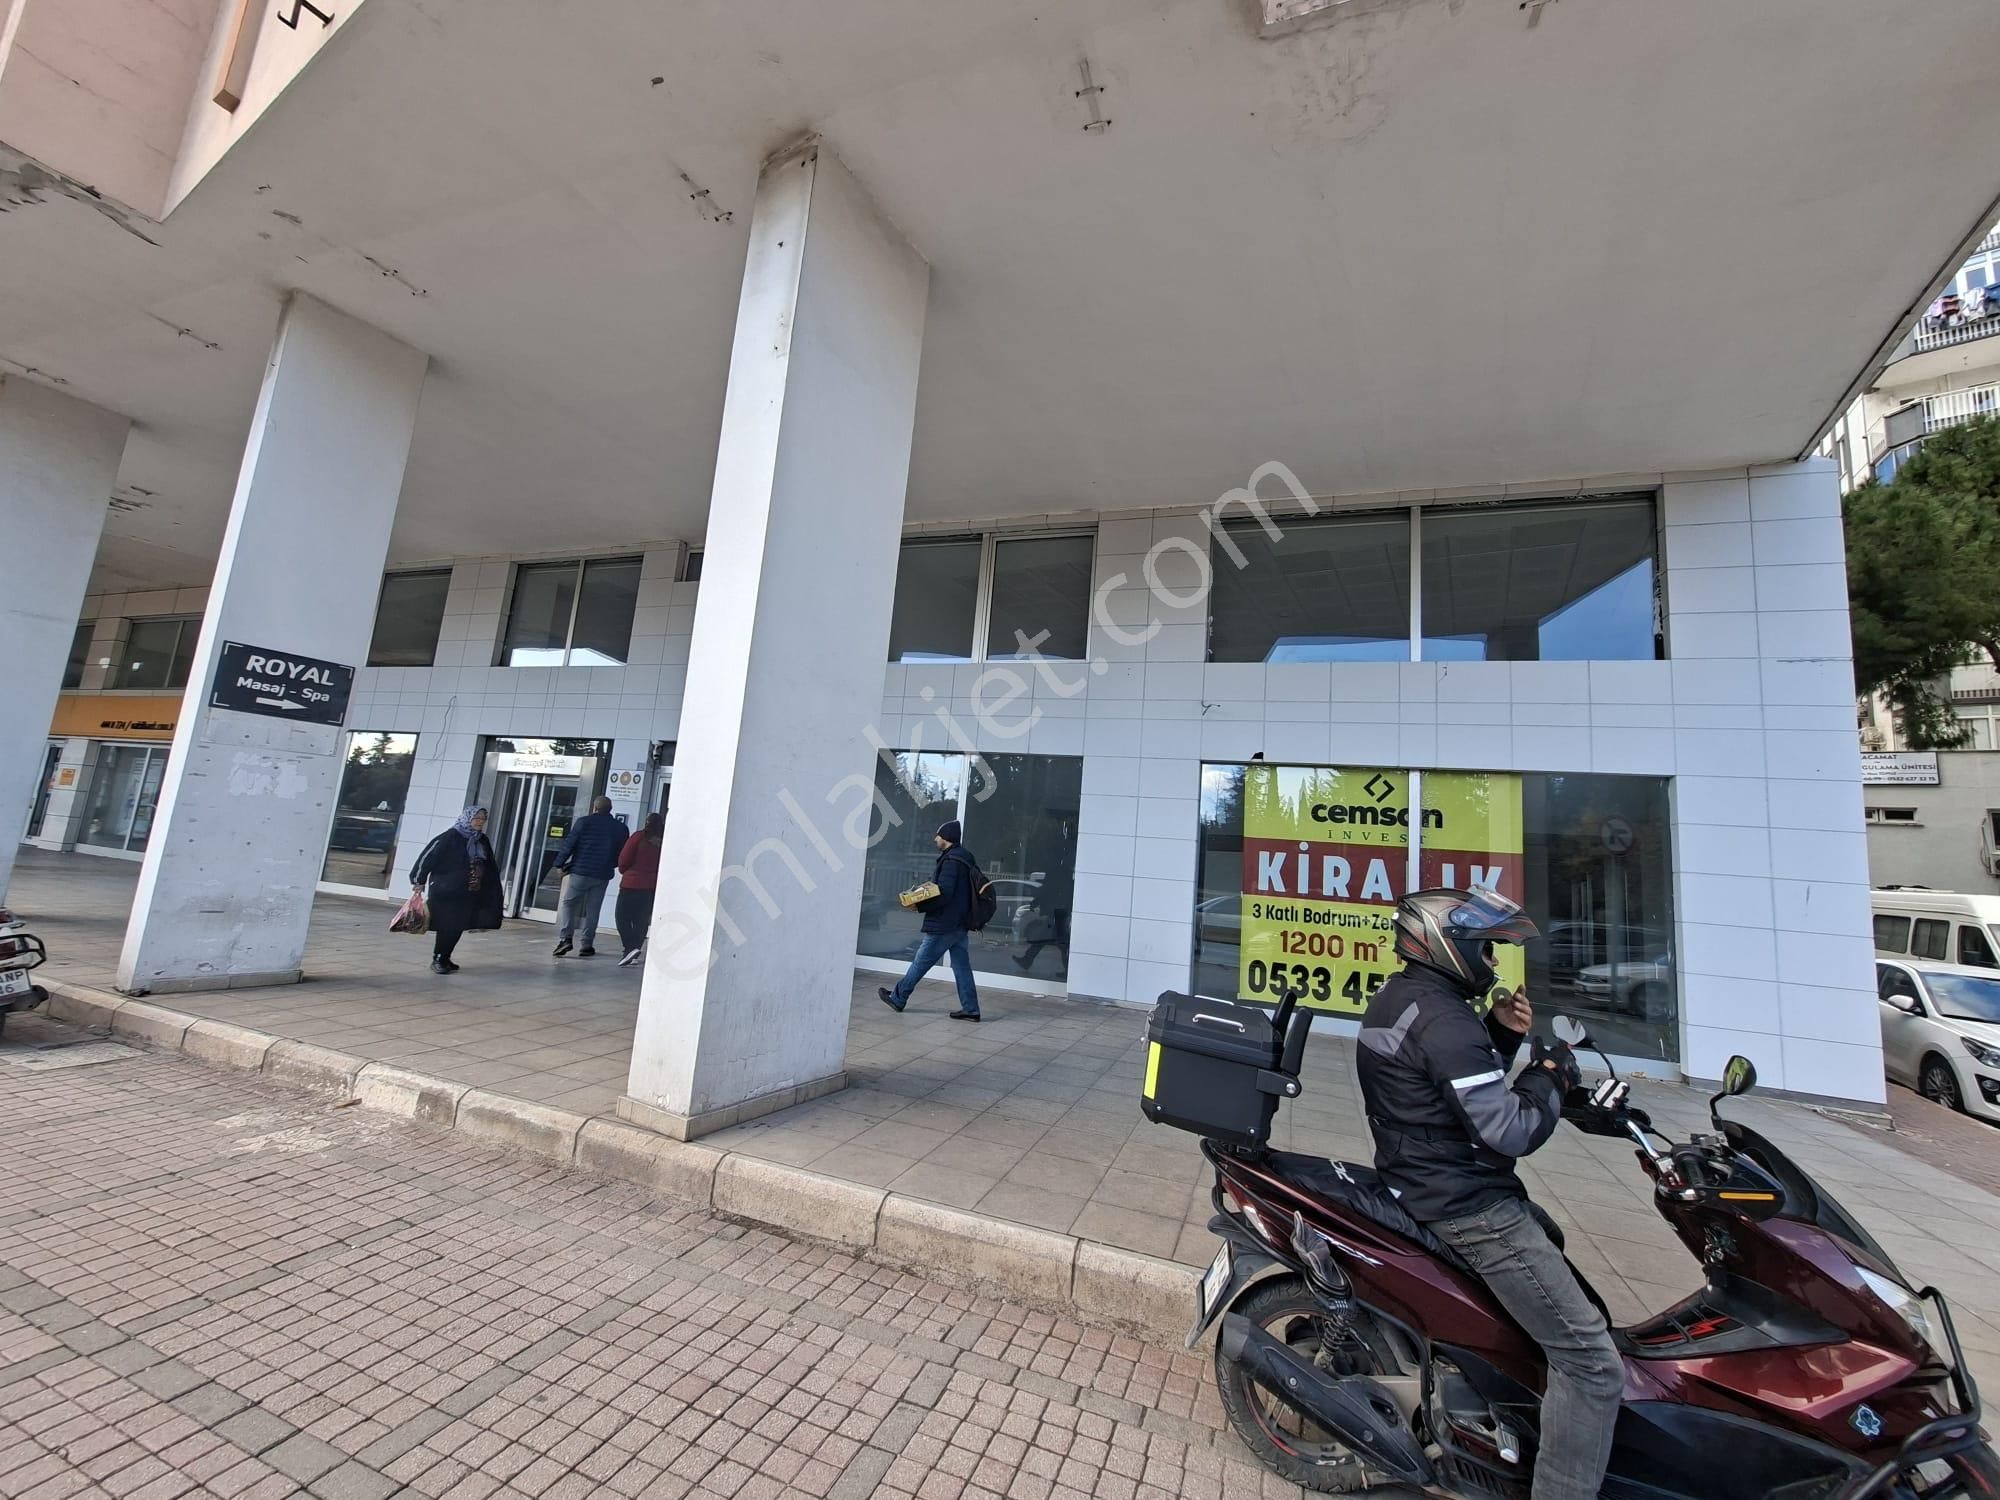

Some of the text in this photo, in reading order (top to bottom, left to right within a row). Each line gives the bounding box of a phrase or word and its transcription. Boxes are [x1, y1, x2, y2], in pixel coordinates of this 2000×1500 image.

[245, 654, 335, 686] ROYAL
[236, 676, 287, 697] Masaj
[301, 688, 330, 703] Spa
[1257, 842, 1503, 901] KİRAIK
[1252, 903, 1262, 919] 3
[1266, 905, 1298, 923] Katlı
[1280, 930, 1344, 959] 1200
[1353, 935, 1388, 963] m²
[1248, 959, 1331, 1001] 0533
